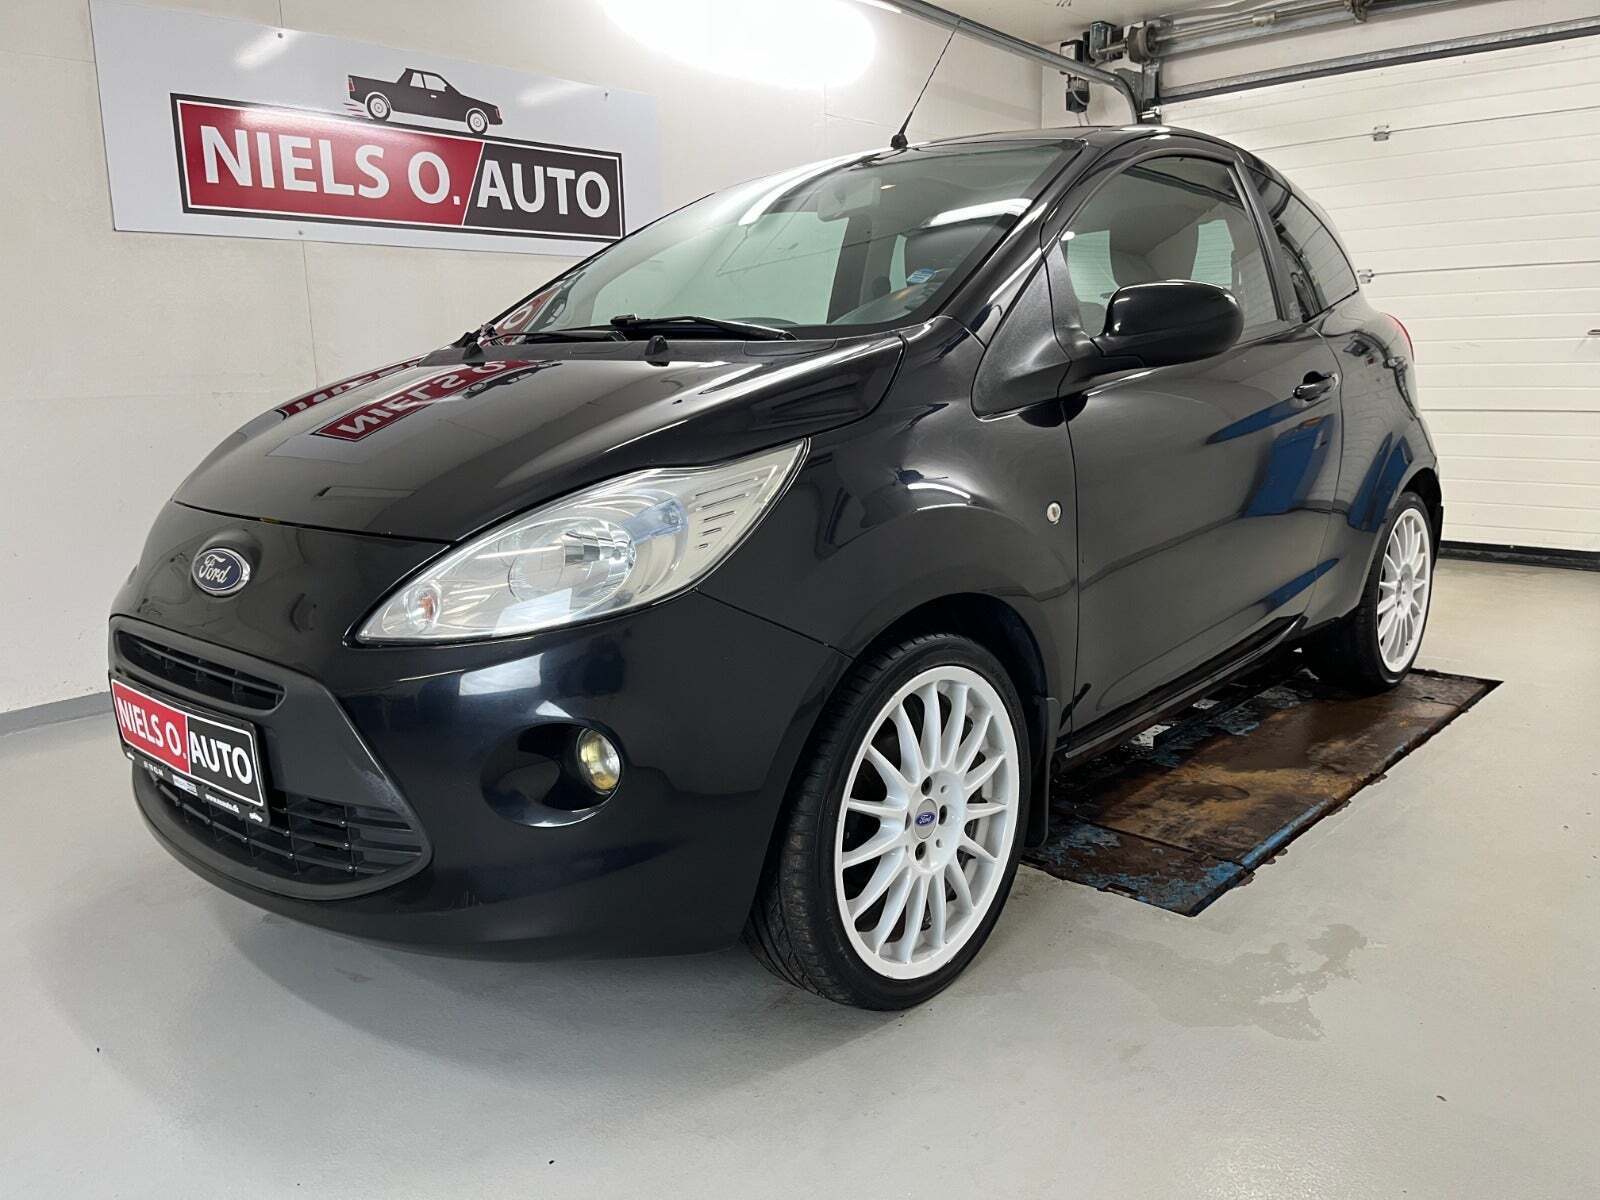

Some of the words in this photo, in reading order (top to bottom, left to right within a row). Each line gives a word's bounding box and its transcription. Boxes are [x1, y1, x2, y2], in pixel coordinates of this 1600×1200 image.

[200, 125, 390, 200] NIELS
[407, 150, 461, 206] O.
[476, 159, 611, 220] AUTO
[198, 554, 232, 583] Ford
[116, 696, 164, 748] NIELS
[165, 720, 187, 760] O.
[189, 730, 253, 786] AUTO
[919, 814, 932, 825] Ford
